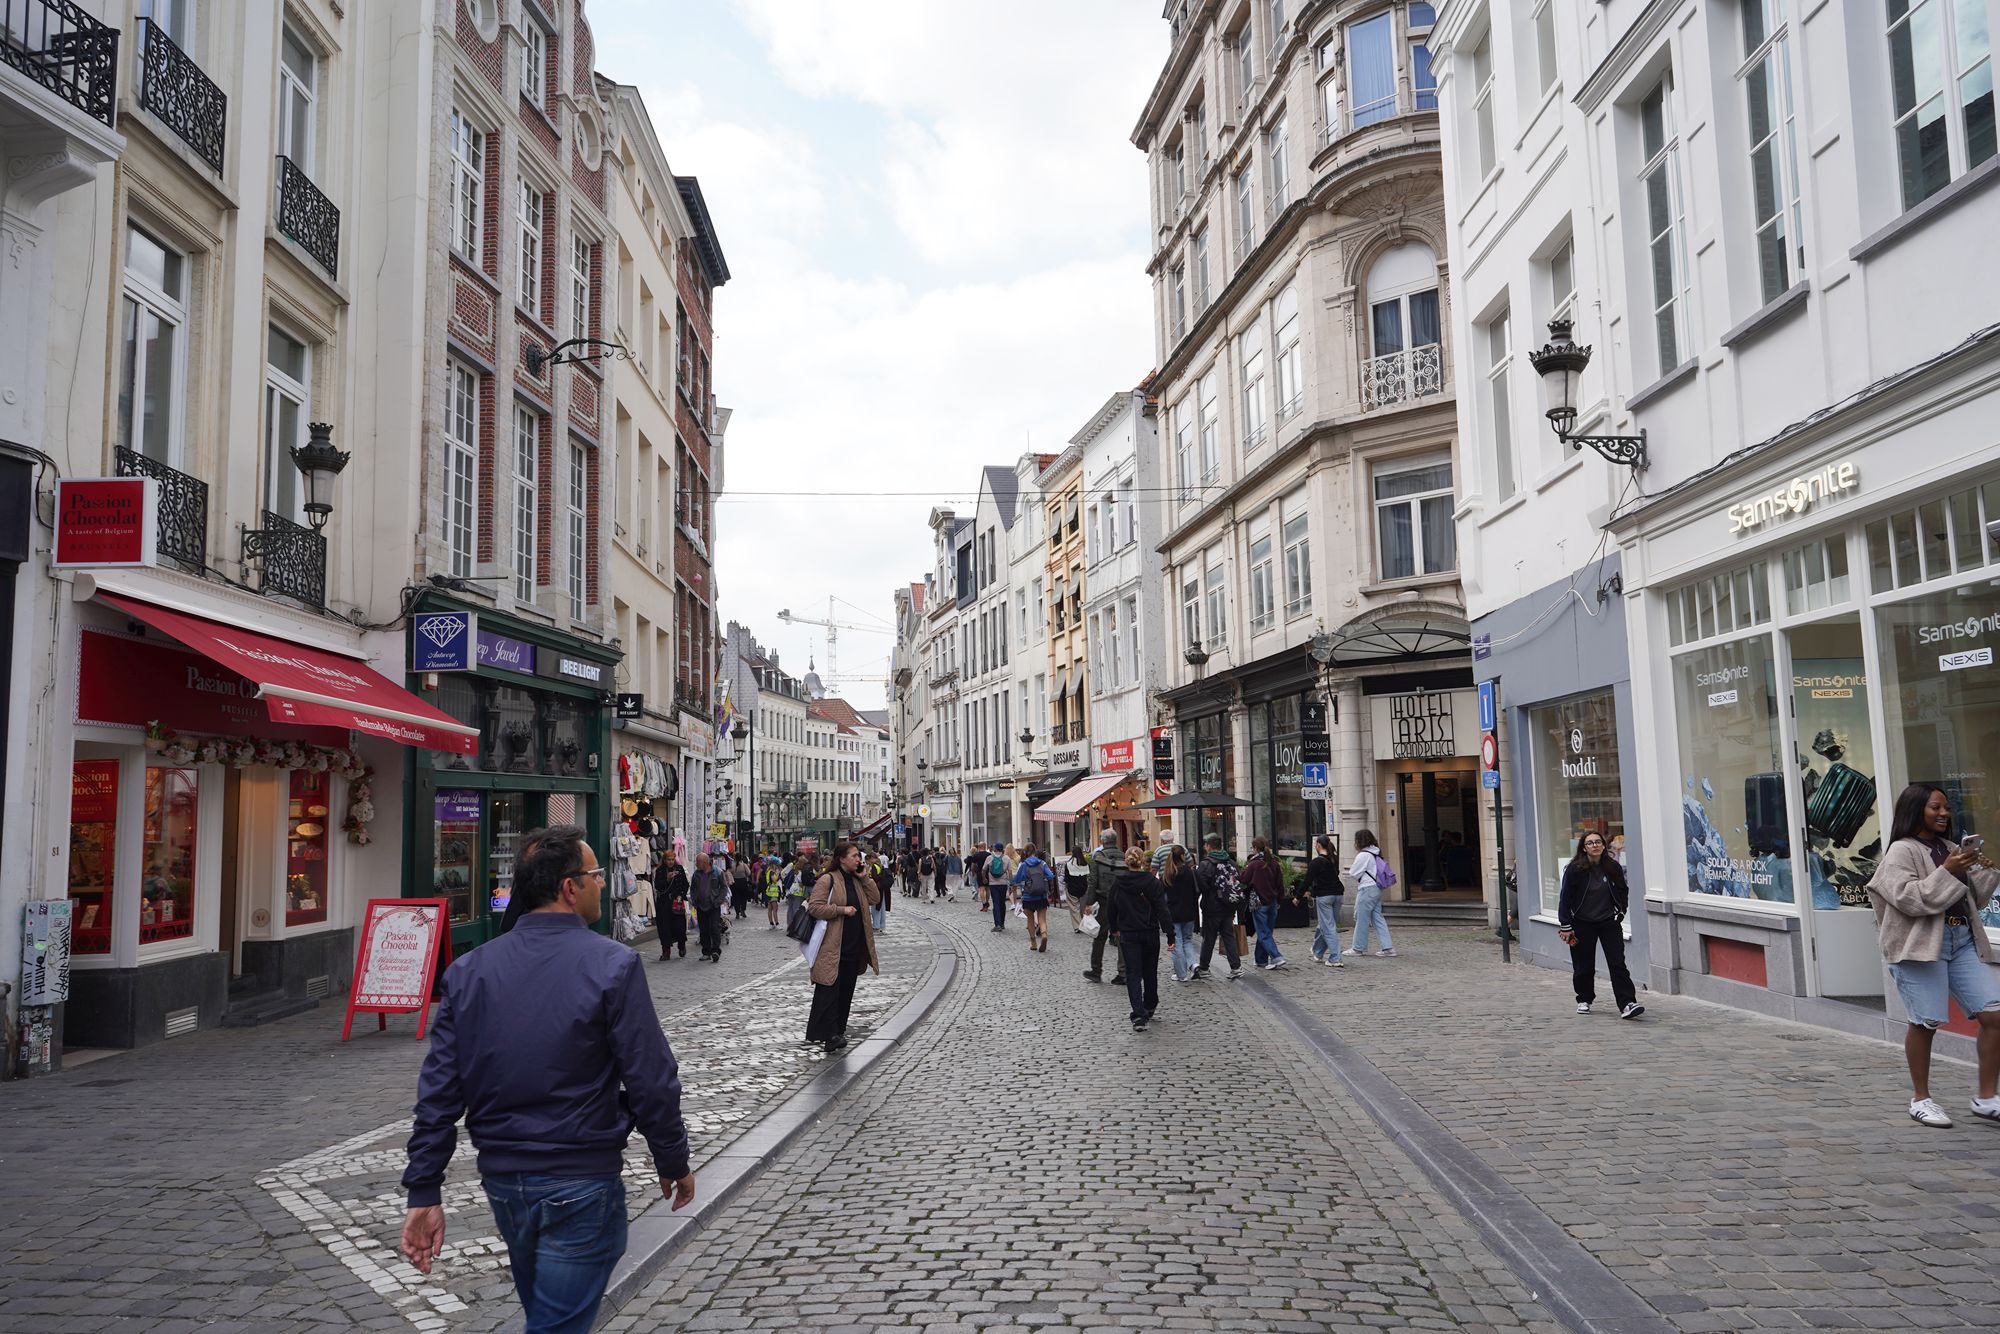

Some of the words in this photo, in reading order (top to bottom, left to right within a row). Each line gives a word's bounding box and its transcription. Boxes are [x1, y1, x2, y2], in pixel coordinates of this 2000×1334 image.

[71, 494, 131, 509] Passion
[1728, 462, 1857, 533] Samsonite
[63, 510, 136, 525] Chocolat
[105, 528, 134, 536] Belgium
[1919, 612, 2000, 644] Samsonit
[427, 651, 456, 659] Antwerp
[490, 640, 520, 664] Jewels
[1942, 652, 1989, 667] NEXIS
[425, 660, 459, 668] Diamonds
[562, 659, 578, 677] BEE
[579, 663, 600, 681] LIGHT
[186, 666, 236, 696] Passion
[1696, 665, 1748, 687] Samsonite
[1793, 675, 1867, 688] Samsonite
[1710, 692, 1736, 703] NEXIS
[1393, 693, 1448, 718] HOTEL
[400, 727, 425, 742] Chocolates
[1399, 717, 1445, 742] ARTS
[1305, 740, 1329, 750] Lloyd
[1053, 749, 1080, 766] DESSANGE
[1156, 764, 1173, 772] Lloyd
[1562, 756, 1598, 778] boddi
[1276, 774, 1291, 784] Coffee
[1707, 857, 1728, 868] SOLID
[1730, 859, 1738, 869] AS
[1740, 860, 1745, 869] A
[1746, 860, 1767, 871] ROCK
[1704, 868, 1749, 883] REMARKABLY
[1750, 874, 1774, 885] LIGHT
[1840, 885, 1852, 894] AS
[385, 932, 417, 940] Passion
[381, 940, 418, 950] Chocolat
